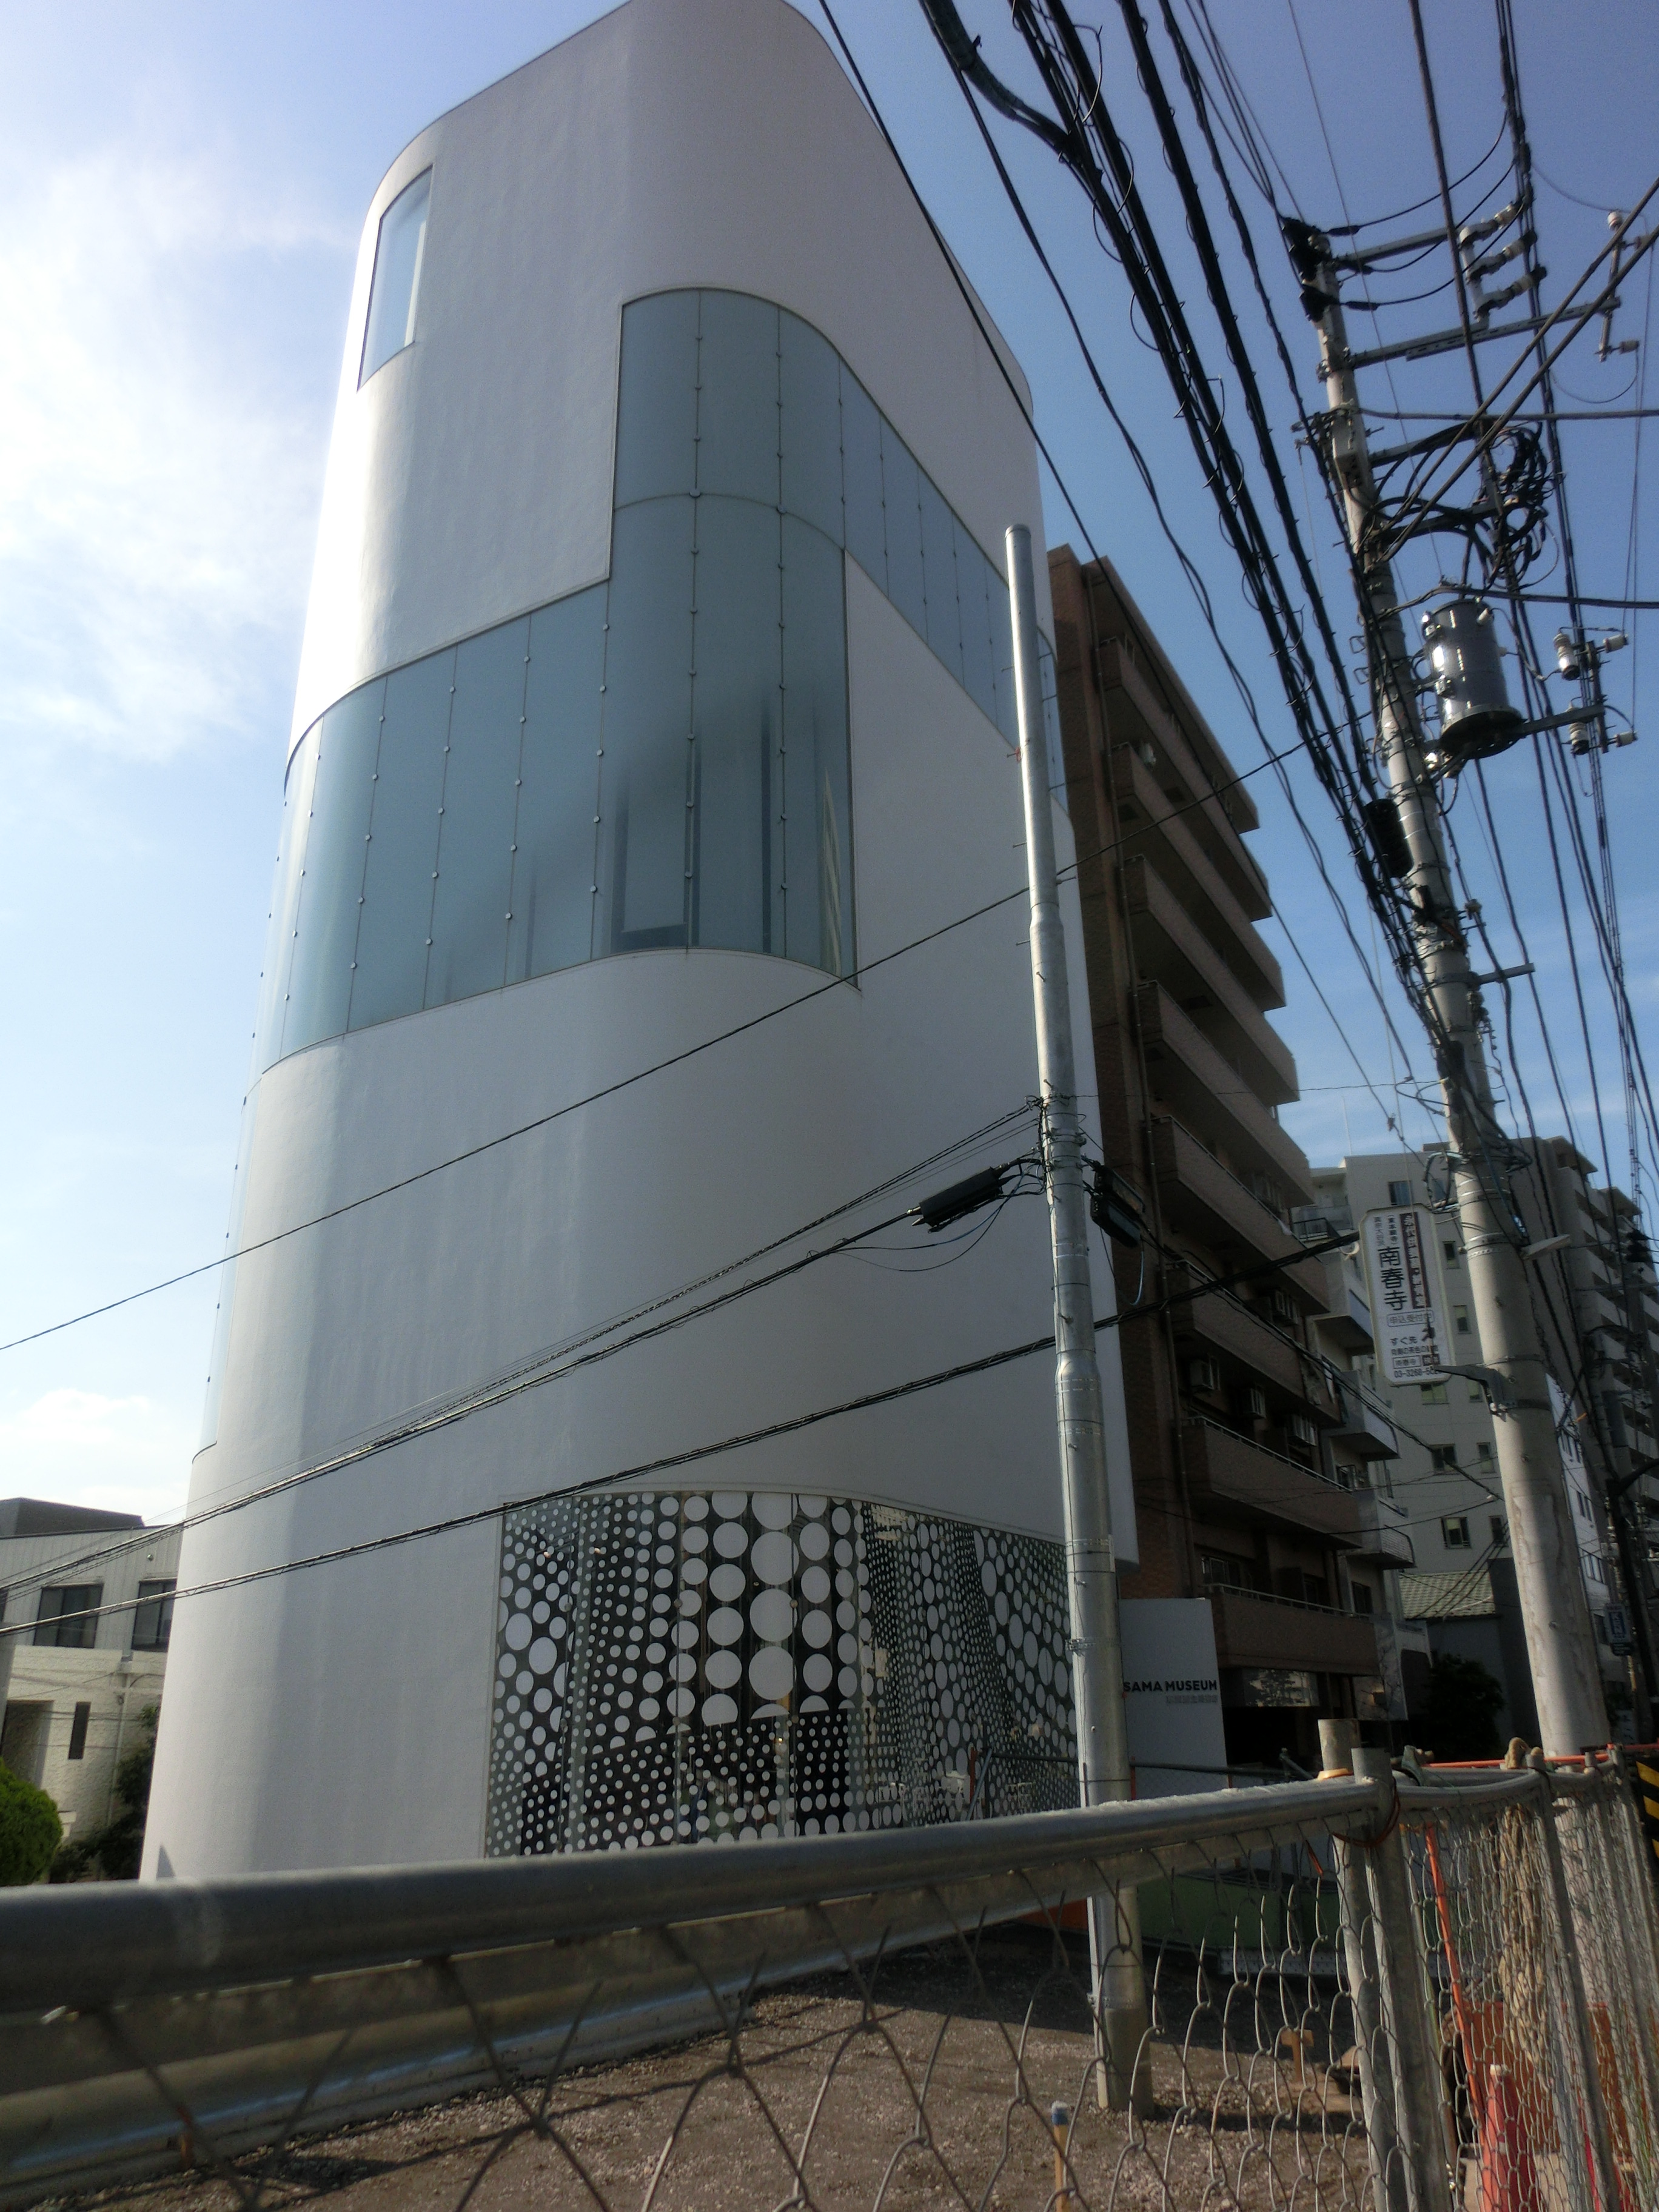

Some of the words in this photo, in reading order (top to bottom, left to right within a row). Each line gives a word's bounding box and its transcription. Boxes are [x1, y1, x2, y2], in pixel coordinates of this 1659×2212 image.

[1378, 1246, 1407, 1311] 南春寺
[1390, 1336, 1418, 1346] すぐ先
[1165, 1680, 1218, 1691] MUSEUM
